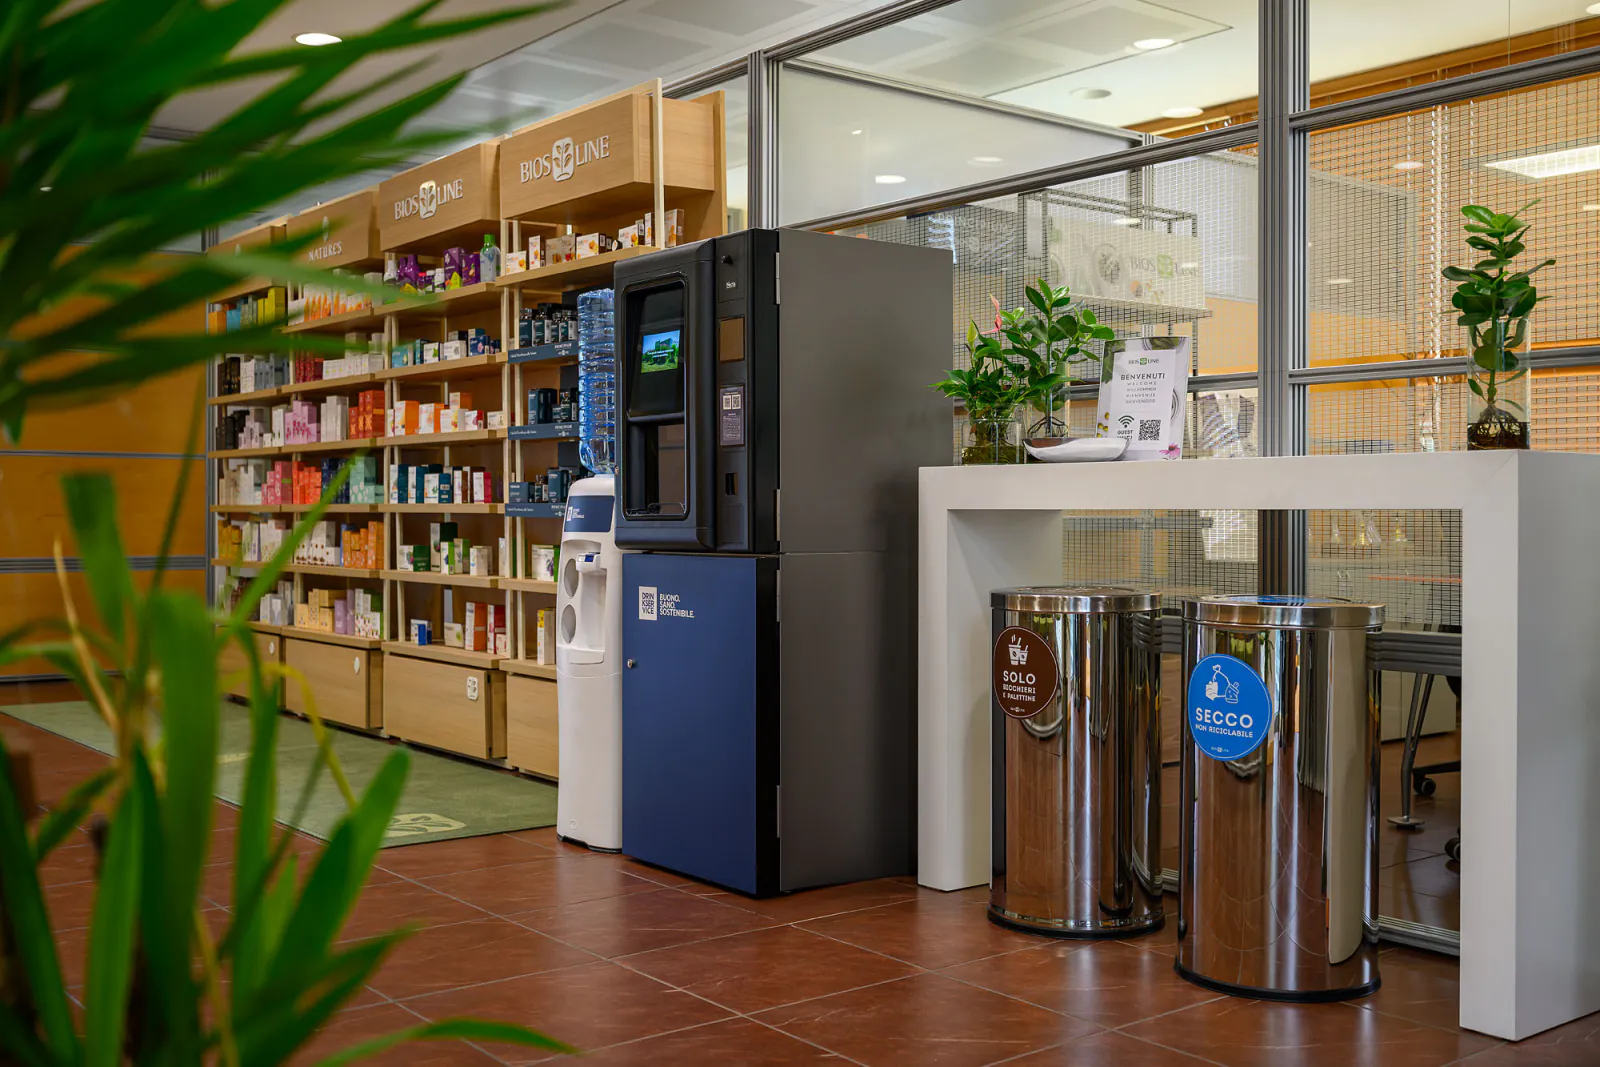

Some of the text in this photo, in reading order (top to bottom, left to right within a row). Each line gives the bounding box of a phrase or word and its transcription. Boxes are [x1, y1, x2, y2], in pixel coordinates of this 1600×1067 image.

[520, 135, 610, 184] BIOS LINE
[394, 179, 463, 220] BIOS LINE
[1003, 670, 1036, 685] SOLO
[1003, 684, 1036, 694] BICCHIERI
[1007, 692, 1036, 702] PALETTINE
[1195, 707, 1254, 729] SECCO
[1195, 723, 1254, 738] NON RICICLABILE
